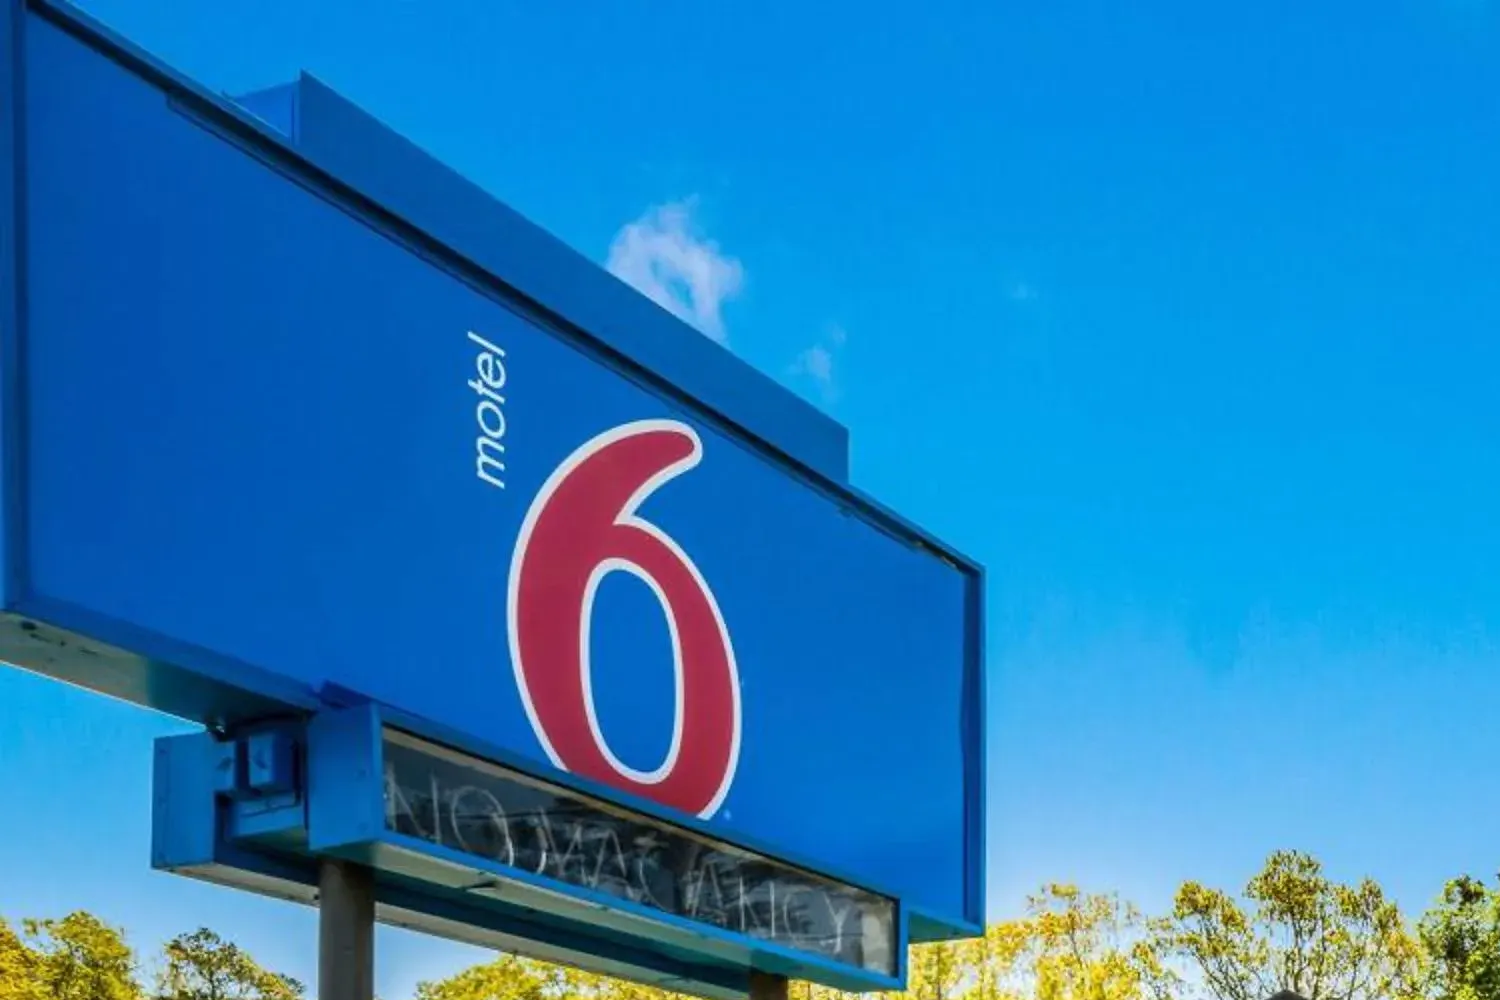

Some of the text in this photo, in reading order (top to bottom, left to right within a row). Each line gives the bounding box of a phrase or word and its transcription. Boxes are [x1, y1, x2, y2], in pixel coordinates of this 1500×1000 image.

[467, 331, 507, 489] motel
[507, 418, 743, 820] 6
[384, 763, 515, 868] NO
